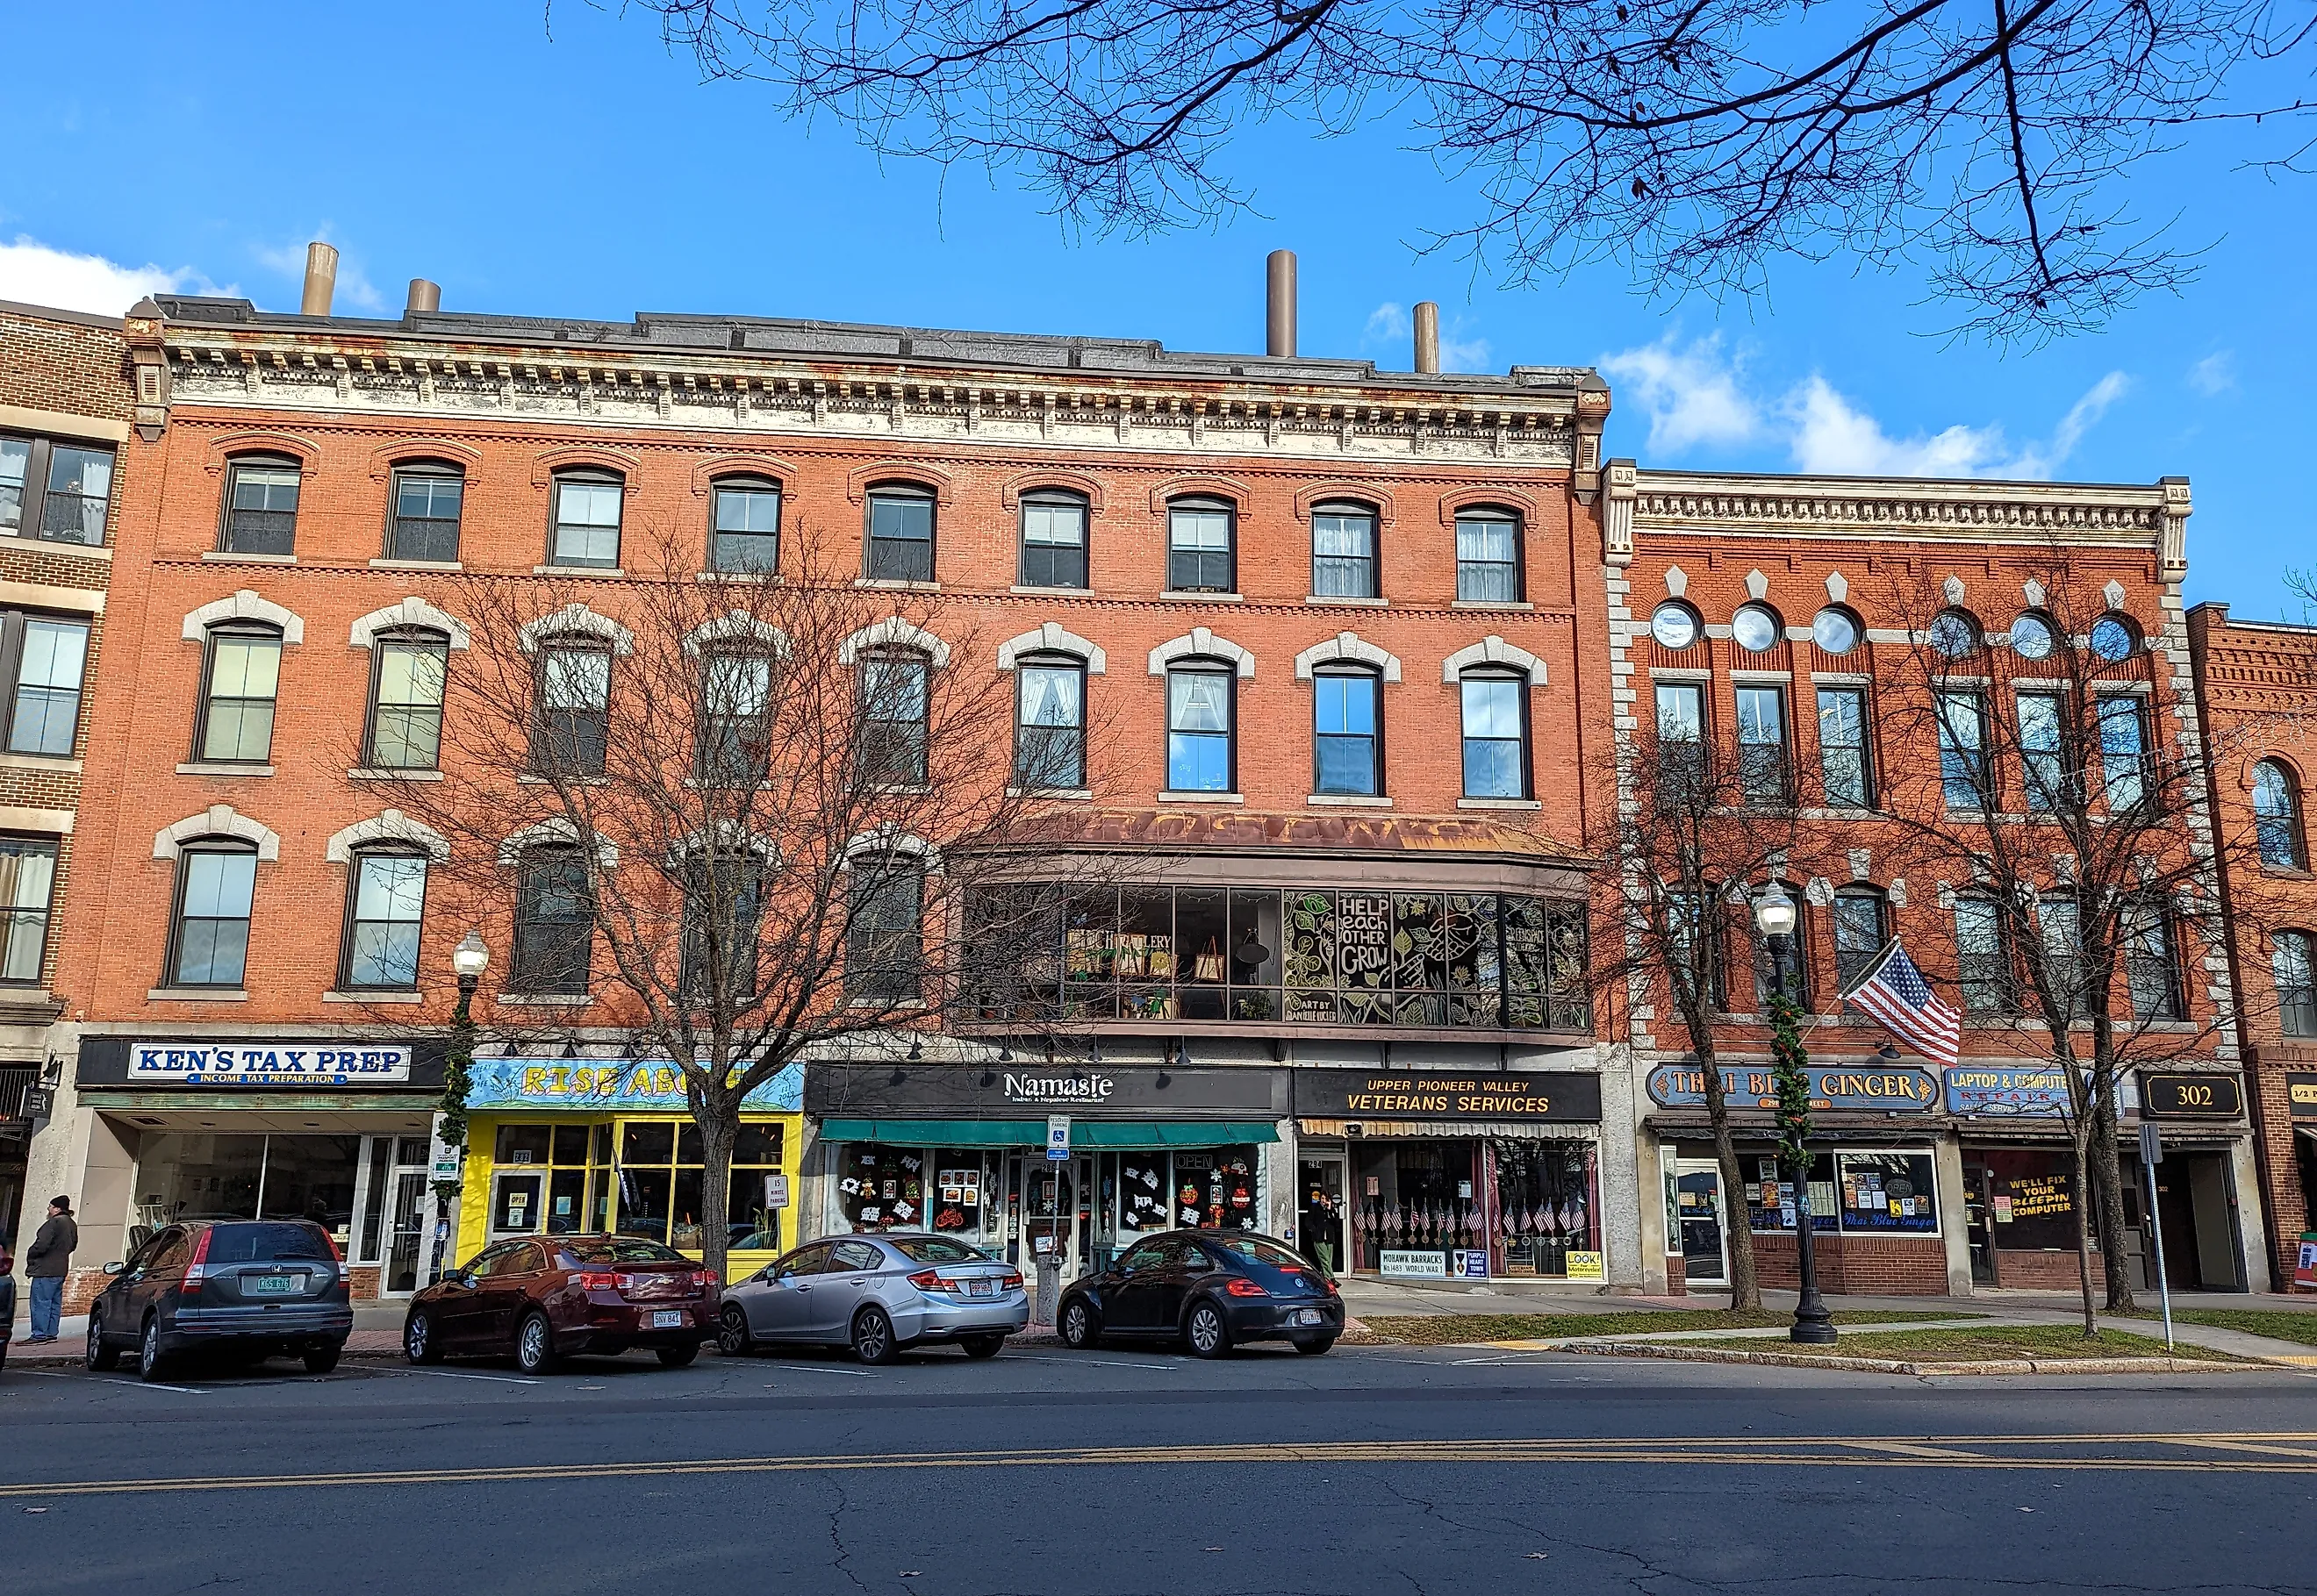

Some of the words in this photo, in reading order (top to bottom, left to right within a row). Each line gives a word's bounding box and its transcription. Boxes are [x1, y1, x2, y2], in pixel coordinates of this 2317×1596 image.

[1340, 898, 1388, 916] HELP
[1342, 915, 1388, 930] each
[1342, 930, 1386, 945] OTHER
[1341, 945, 1388, 974] GROW
[137, 1046, 234, 1071] KEN'S
[241, 1051, 310, 1072] TAX
[315, 1051, 402, 1073] PREP
[200, 1074, 243, 1084] INCOME
[245, 1075, 265, 1084] TAX
[268, 1075, 335, 1084] PREPARATION
[521, 1066, 621, 1096] RISE
[1367, 1080, 1411, 1091] UPPER
[1417, 1081, 1475, 1091] PIONEER
[1482, 1082, 1530, 1092] VALLEY
[1671, 1071, 1736, 1094] THI
[1820, 1074, 1917, 1100] GINGER
[1951, 1073, 1998, 1088] LAPTOP
[2002, 1074, 2012, 1088] &
[2015, 1074, 2068, 1090] COMPUTE
[1960, 1091, 2051, 1102] REPAIR
[2177, 1085, 2213, 1106] 302
[1346, 1094, 1448, 1112] VETERANS
[1457, 1096, 1549, 1113] SERVICES
[1177, 1156, 1211, 1168] OPEN
[1887, 1183, 1912, 1193] OPEN
[2010, 1178, 2044, 1189] WE'LL
[2047, 1176, 2067, 1185] FIX
[2023, 1185, 2055, 1197] YOUR
[2011, 1192, 2070, 1206] BLEEPIN
[2012, 1202, 2072, 1217] COMPUTER
[1843, 1213, 1868, 1226] Thai
[1870, 1213, 1897, 1226] Blue
[1900, 1215, 1936, 1229] Ginger
[1383, 1254, 1410, 1263] MOHAWK
[1411, 1255, 1443, 1264] BARRACKS
[1567, 1254, 1600, 1263] LOOK!
[276, 1278, 289, 1289] 676
[667, 1314, 679, 1323] 841
